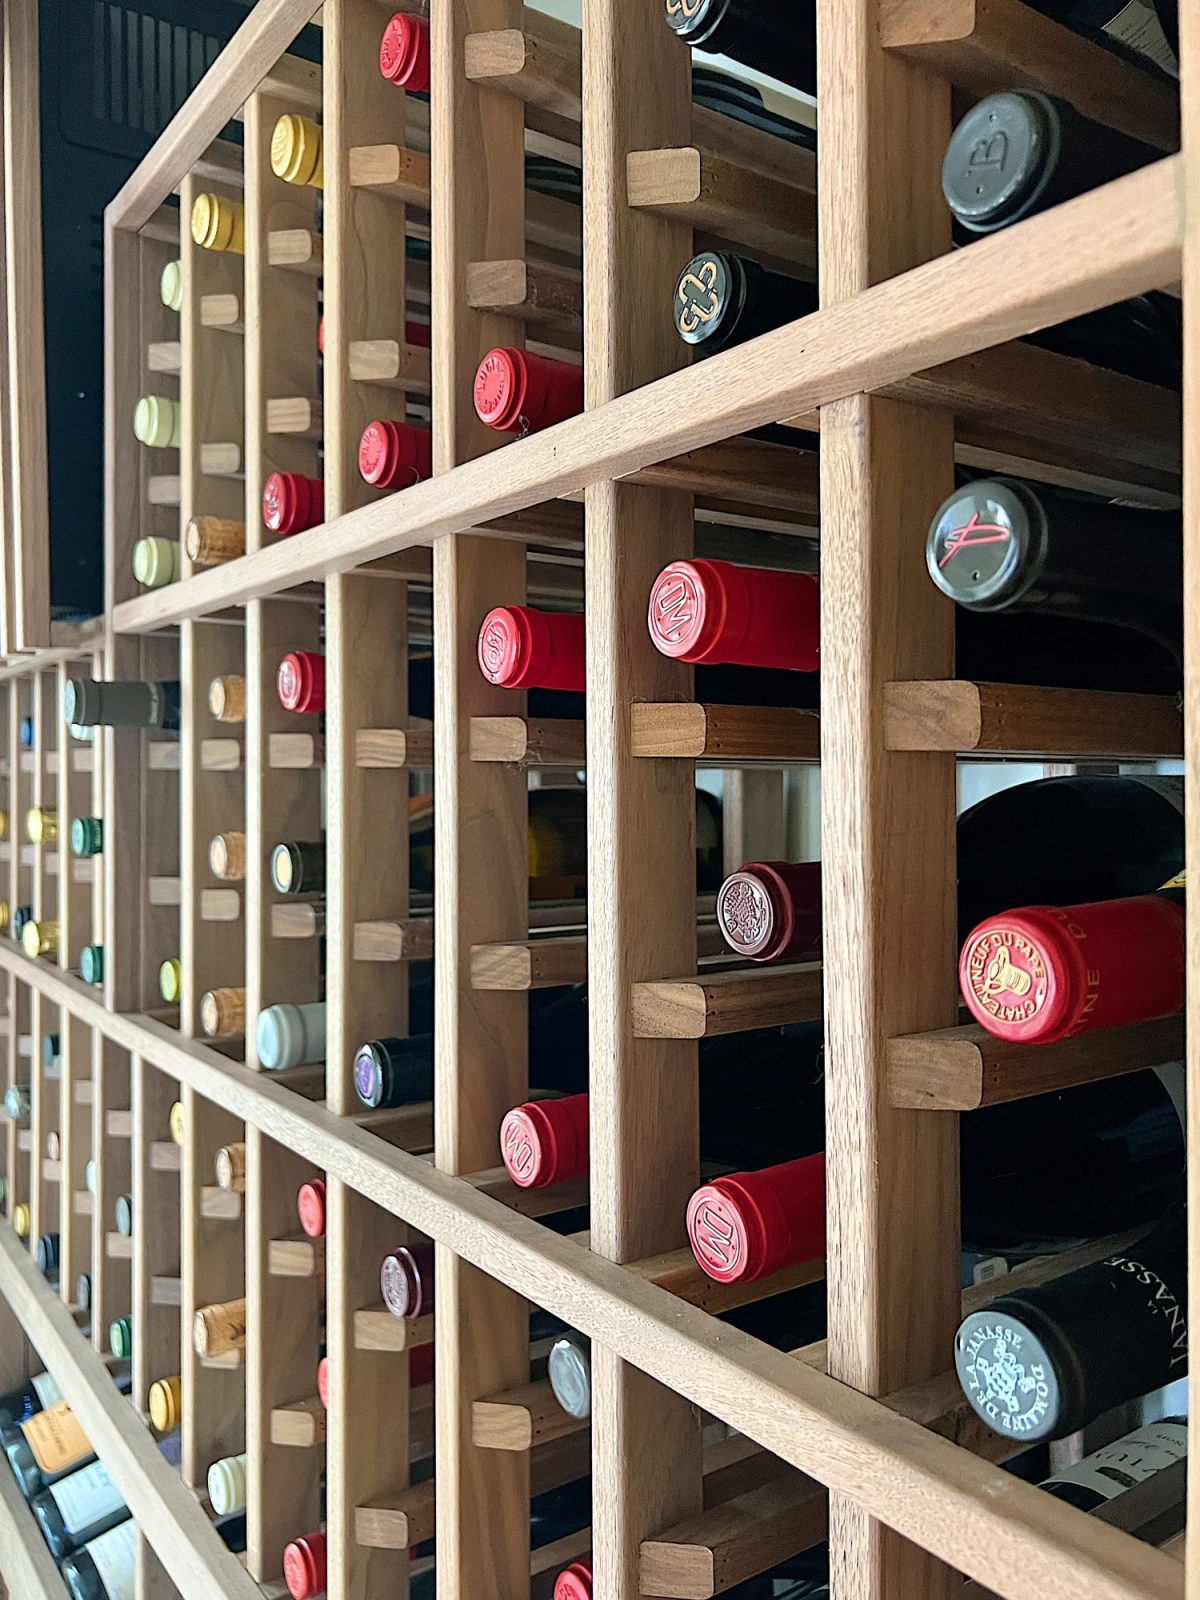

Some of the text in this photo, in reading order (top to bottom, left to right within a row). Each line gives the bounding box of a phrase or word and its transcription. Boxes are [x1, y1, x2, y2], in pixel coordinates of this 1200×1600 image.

[990, 933, 1013, 948] DU
[1014, 936, 1045, 979] PAPE
[965, 1325, 1049, 1432] DOMAINE DE LA JANASSE
